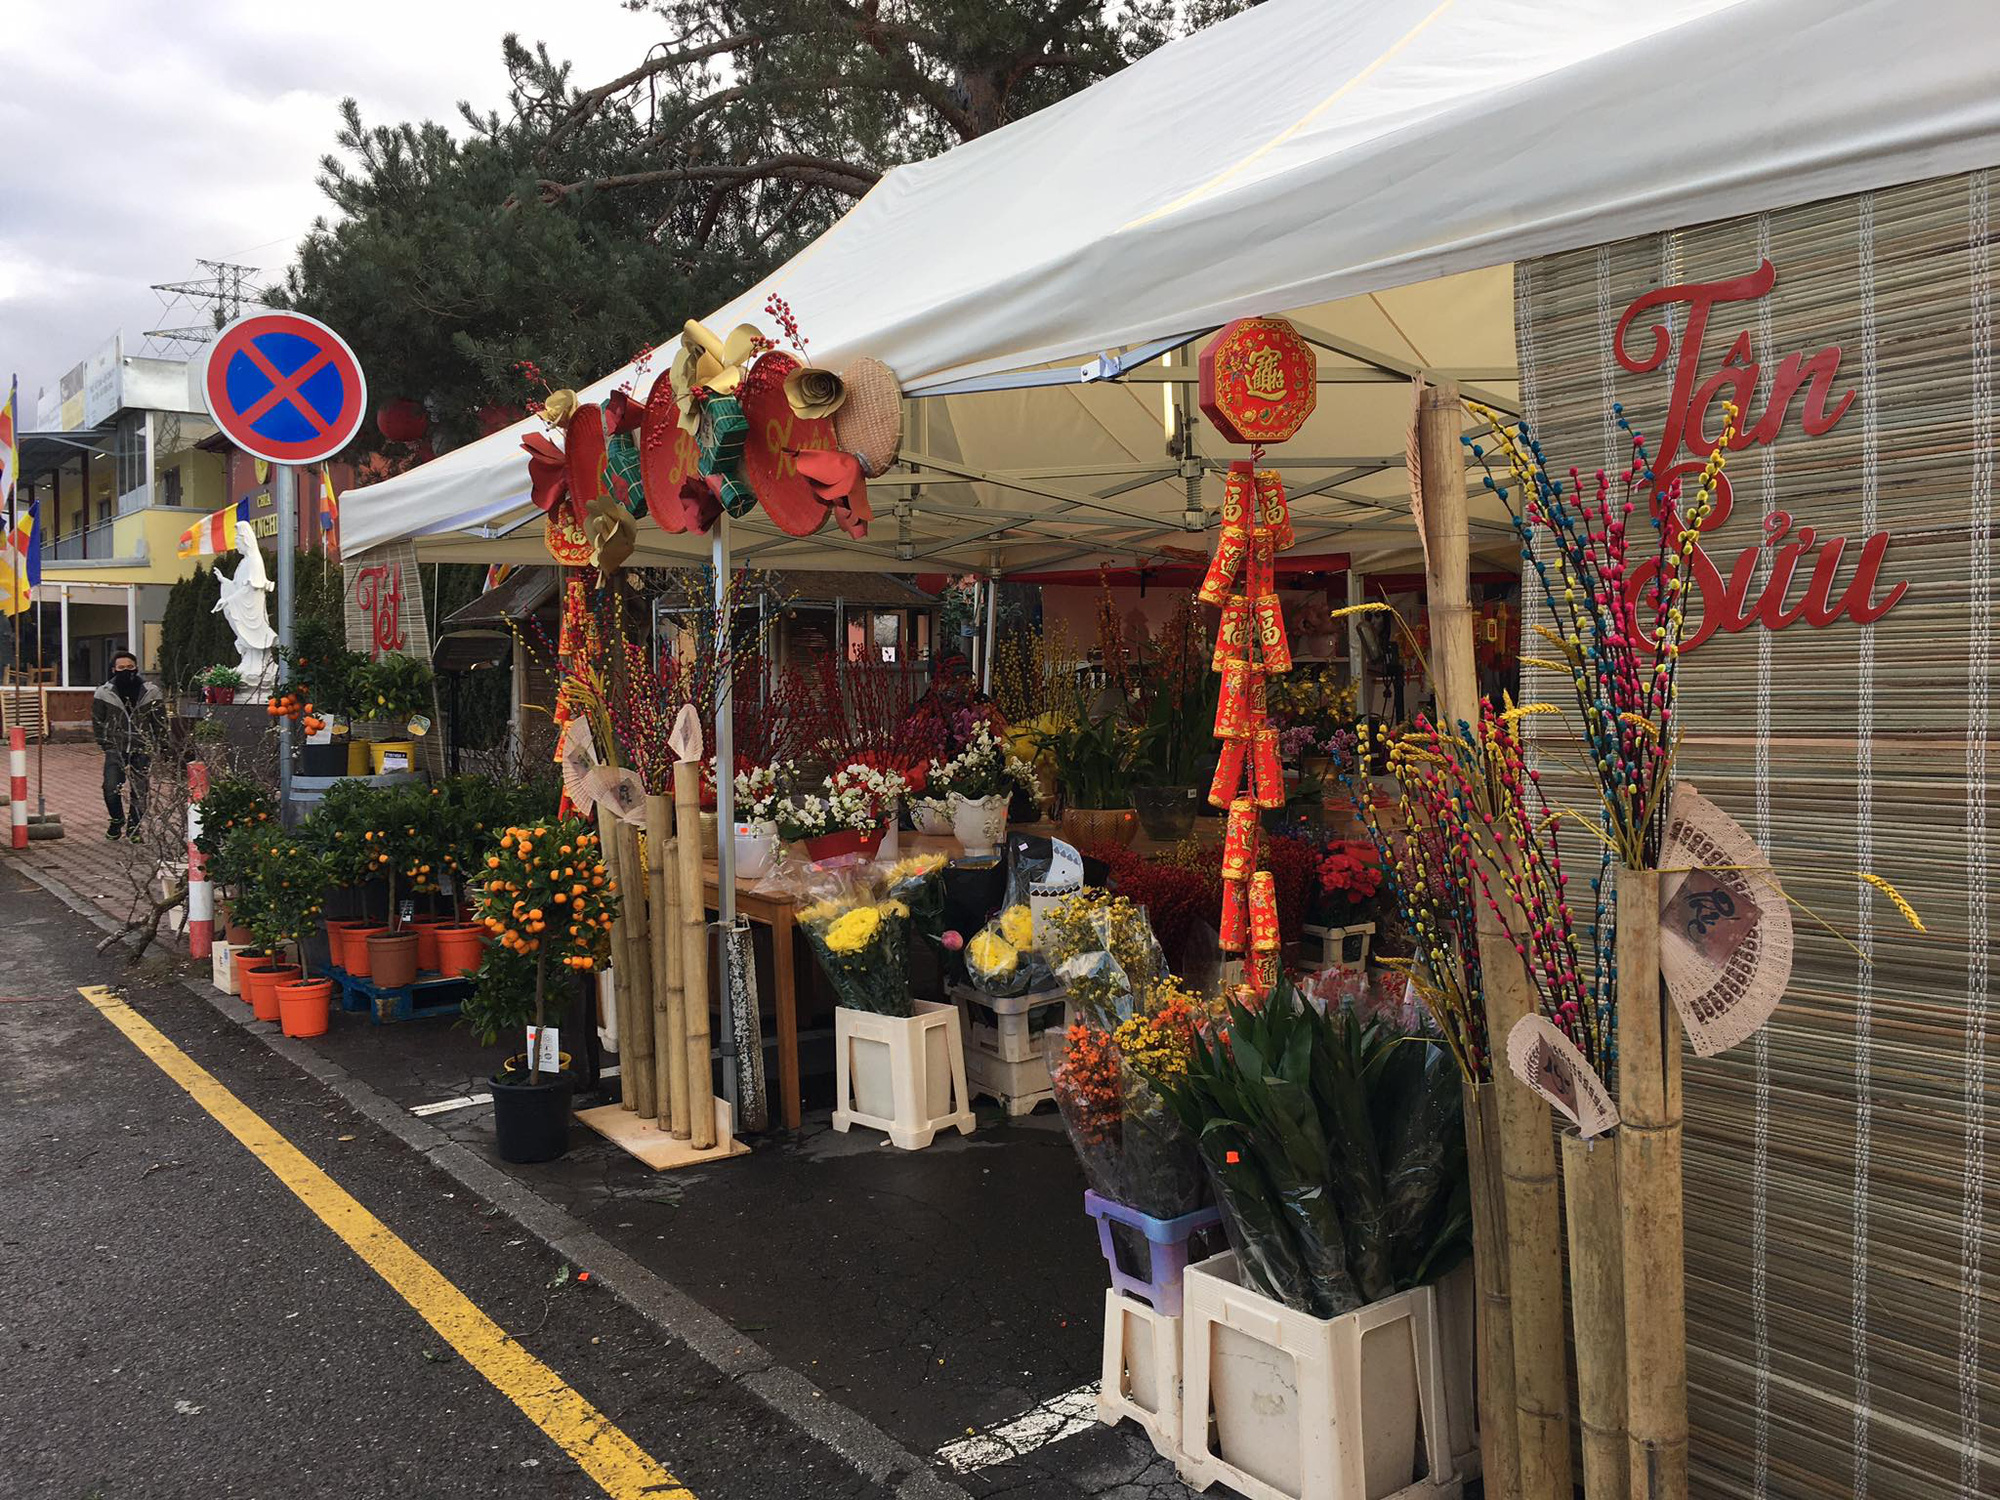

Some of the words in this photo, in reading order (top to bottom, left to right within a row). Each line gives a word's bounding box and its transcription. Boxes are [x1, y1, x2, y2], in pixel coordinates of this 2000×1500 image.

[1614, 258, 1857, 490] Tân
[357, 563, 407, 665] Tết
[1624, 462, 1909, 654] Sửu
